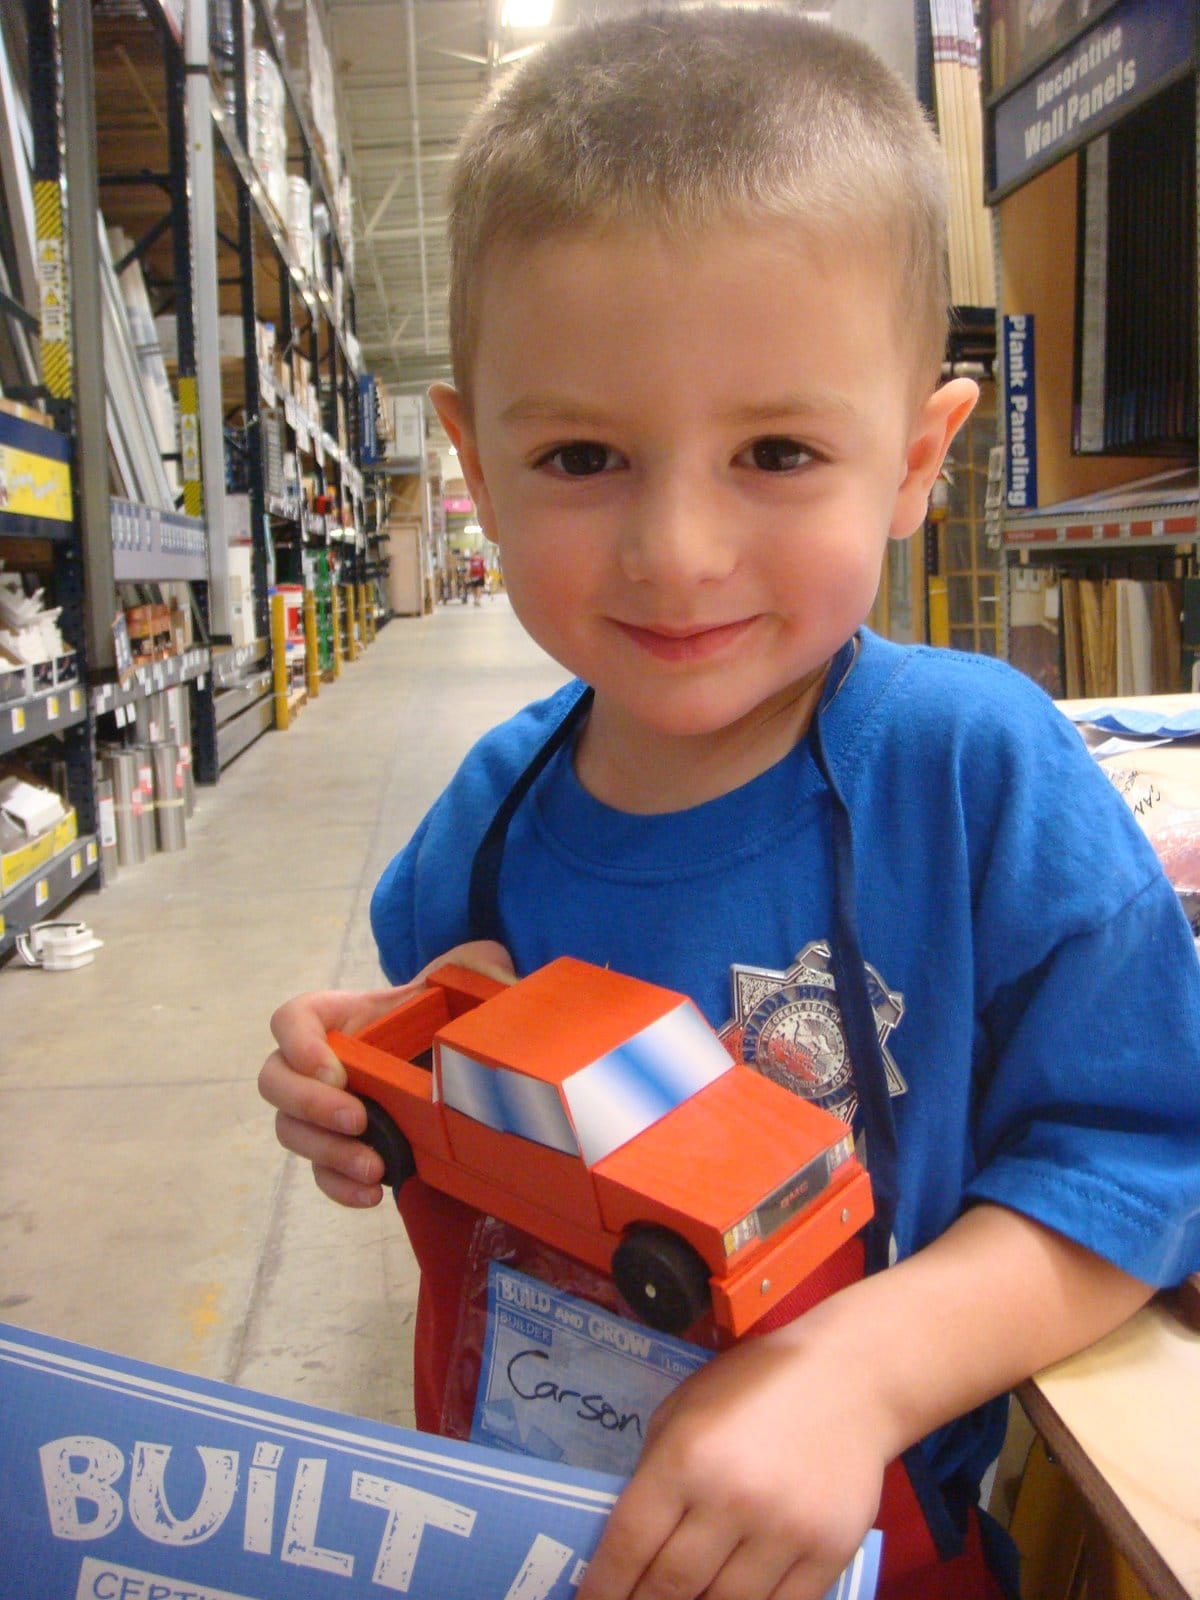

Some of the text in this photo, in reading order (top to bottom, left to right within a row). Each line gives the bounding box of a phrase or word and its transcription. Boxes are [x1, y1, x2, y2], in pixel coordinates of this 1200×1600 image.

[1025, 59, 1136, 160] Wall Panels
[1036, 26, 1122, 111] Decorative
[1008, 315, 1030, 507] Plank Paneling
[773, 1003, 802, 1024] GREAT
[805, 1002, 829, 1018] SEAL
[499, 1311, 552, 1345] BUILDER
[554, 1307, 584, 1330] AND
[587, 1312, 652, 1358] GROW
[507, 1350, 643, 1438] Carson
